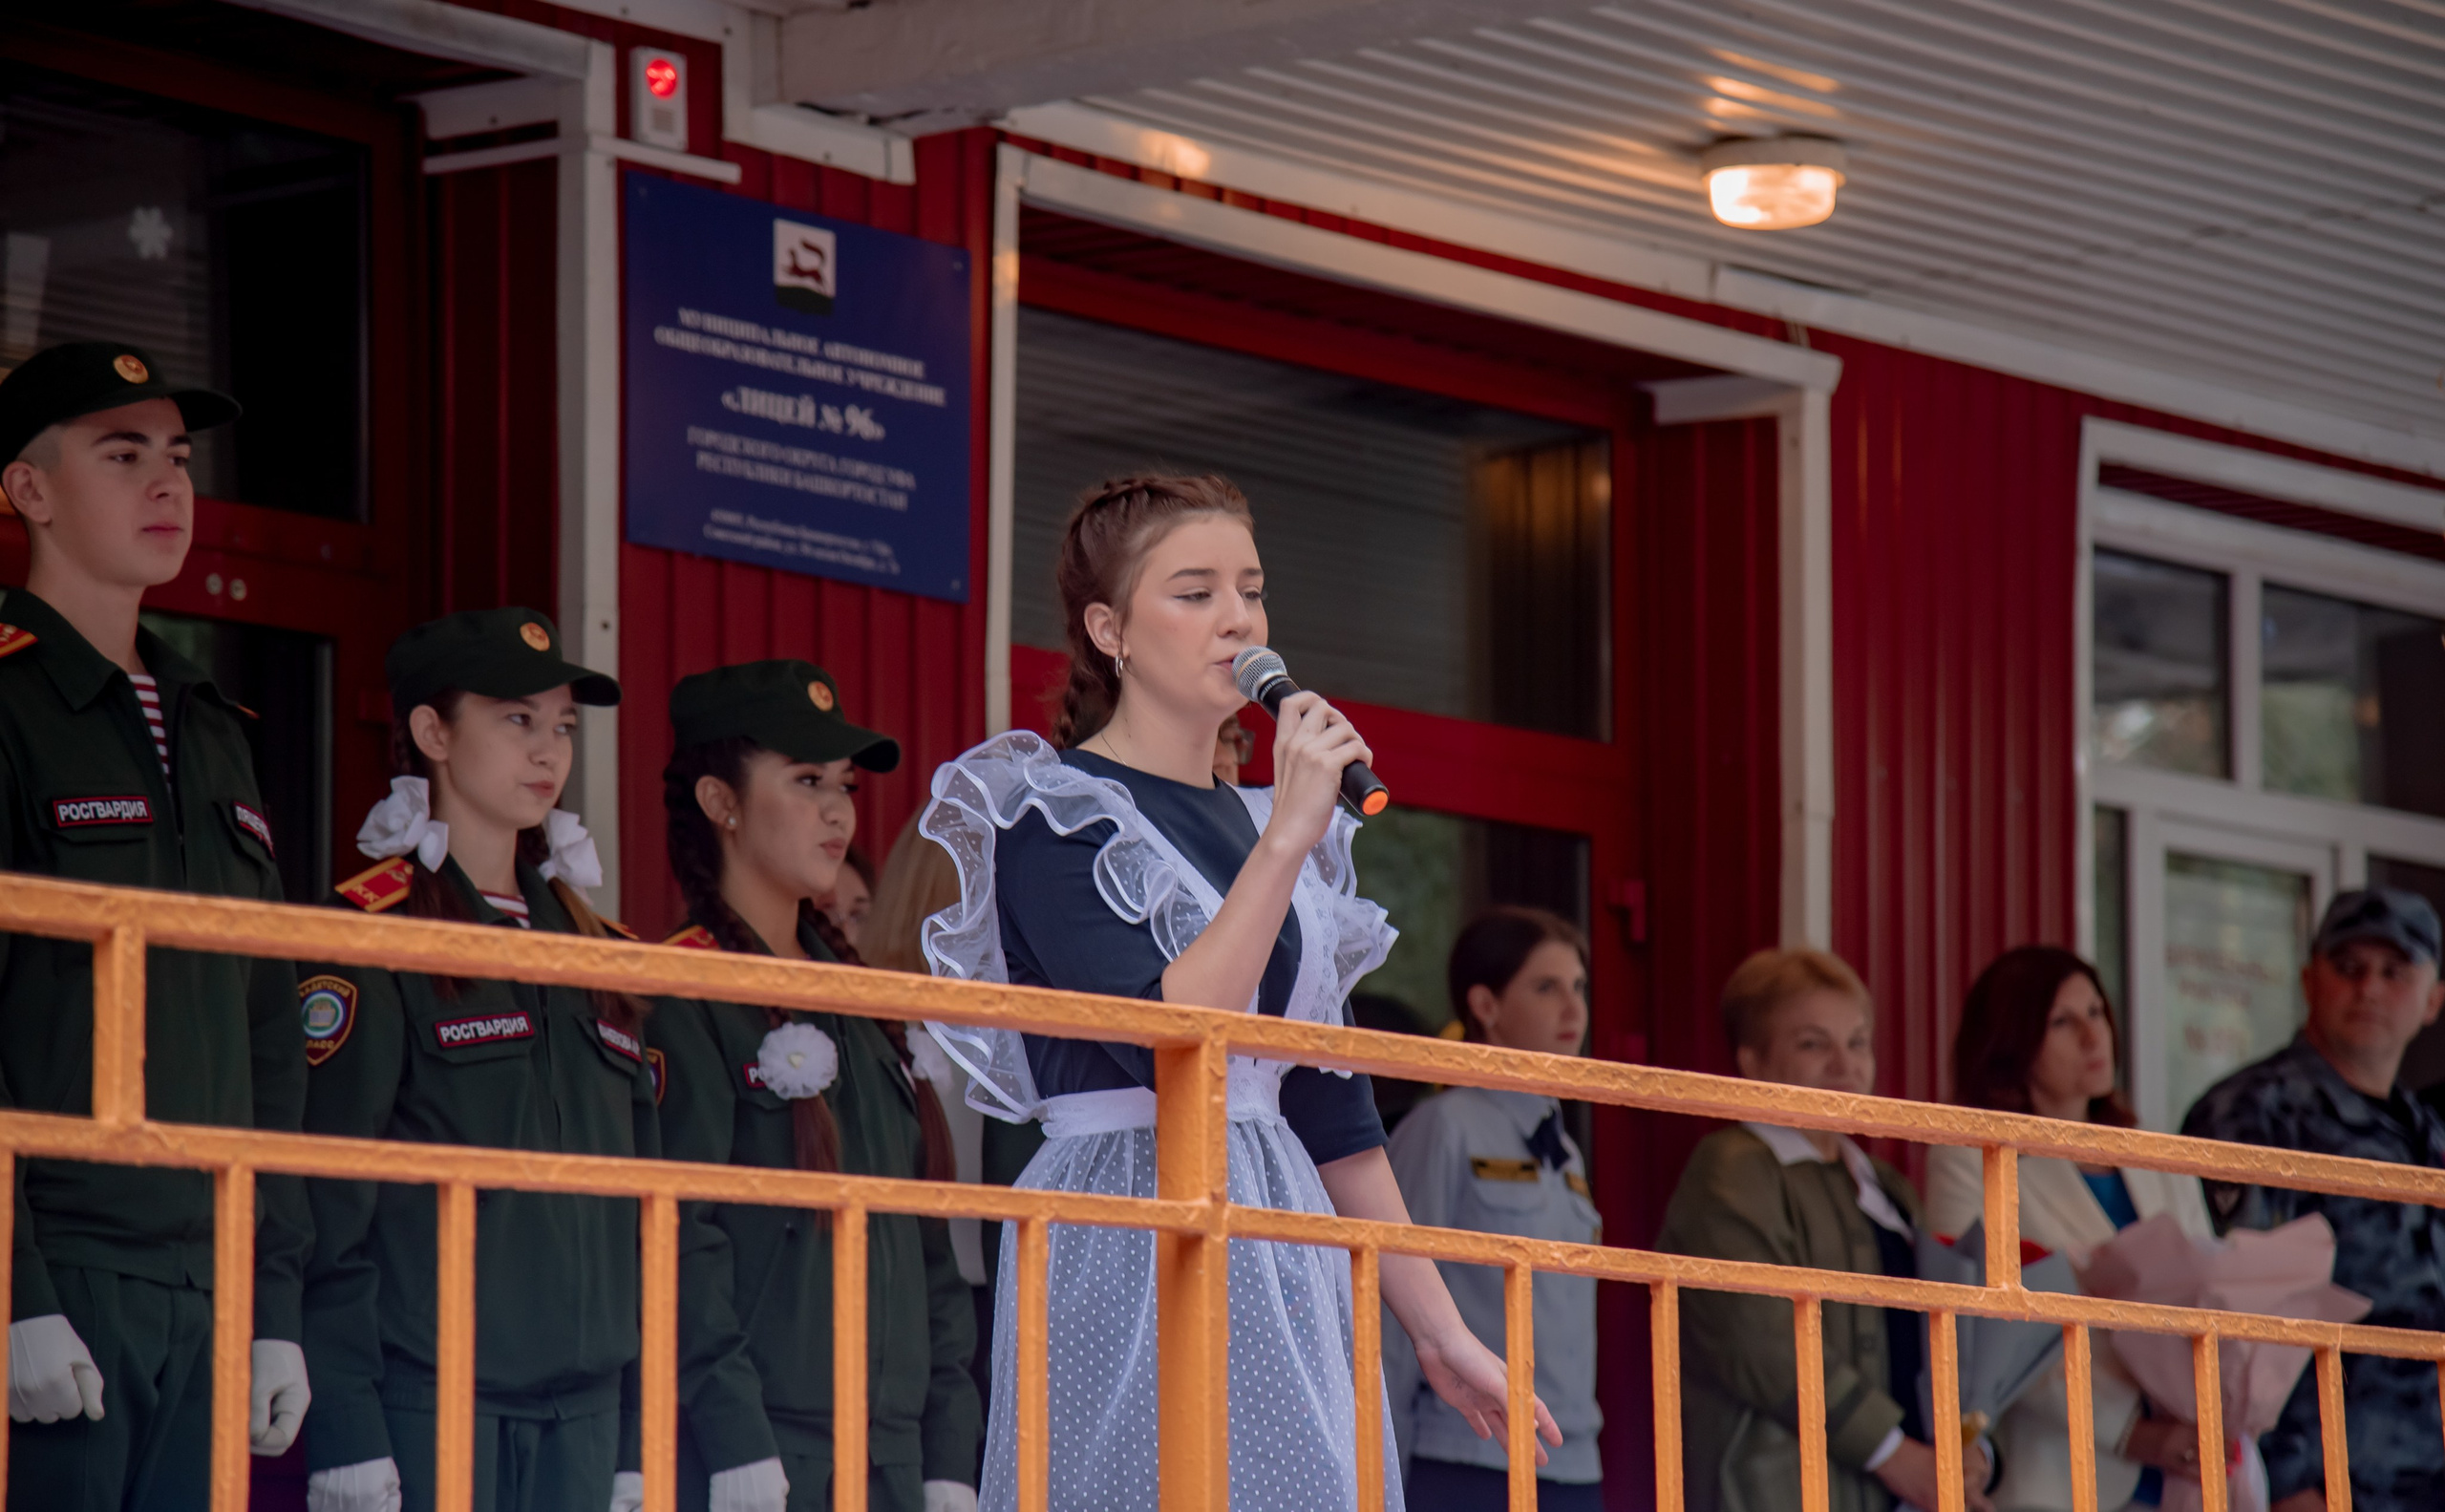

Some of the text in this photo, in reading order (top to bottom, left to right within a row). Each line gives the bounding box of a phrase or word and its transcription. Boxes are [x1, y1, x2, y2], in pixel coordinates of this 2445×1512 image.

[57, 800, 148, 821] РОСГВАРДИЯ
[439, 1016, 529, 1043] РОСГВАРДИЯ
[306, 1039, 335, 1049] ЛАСС
